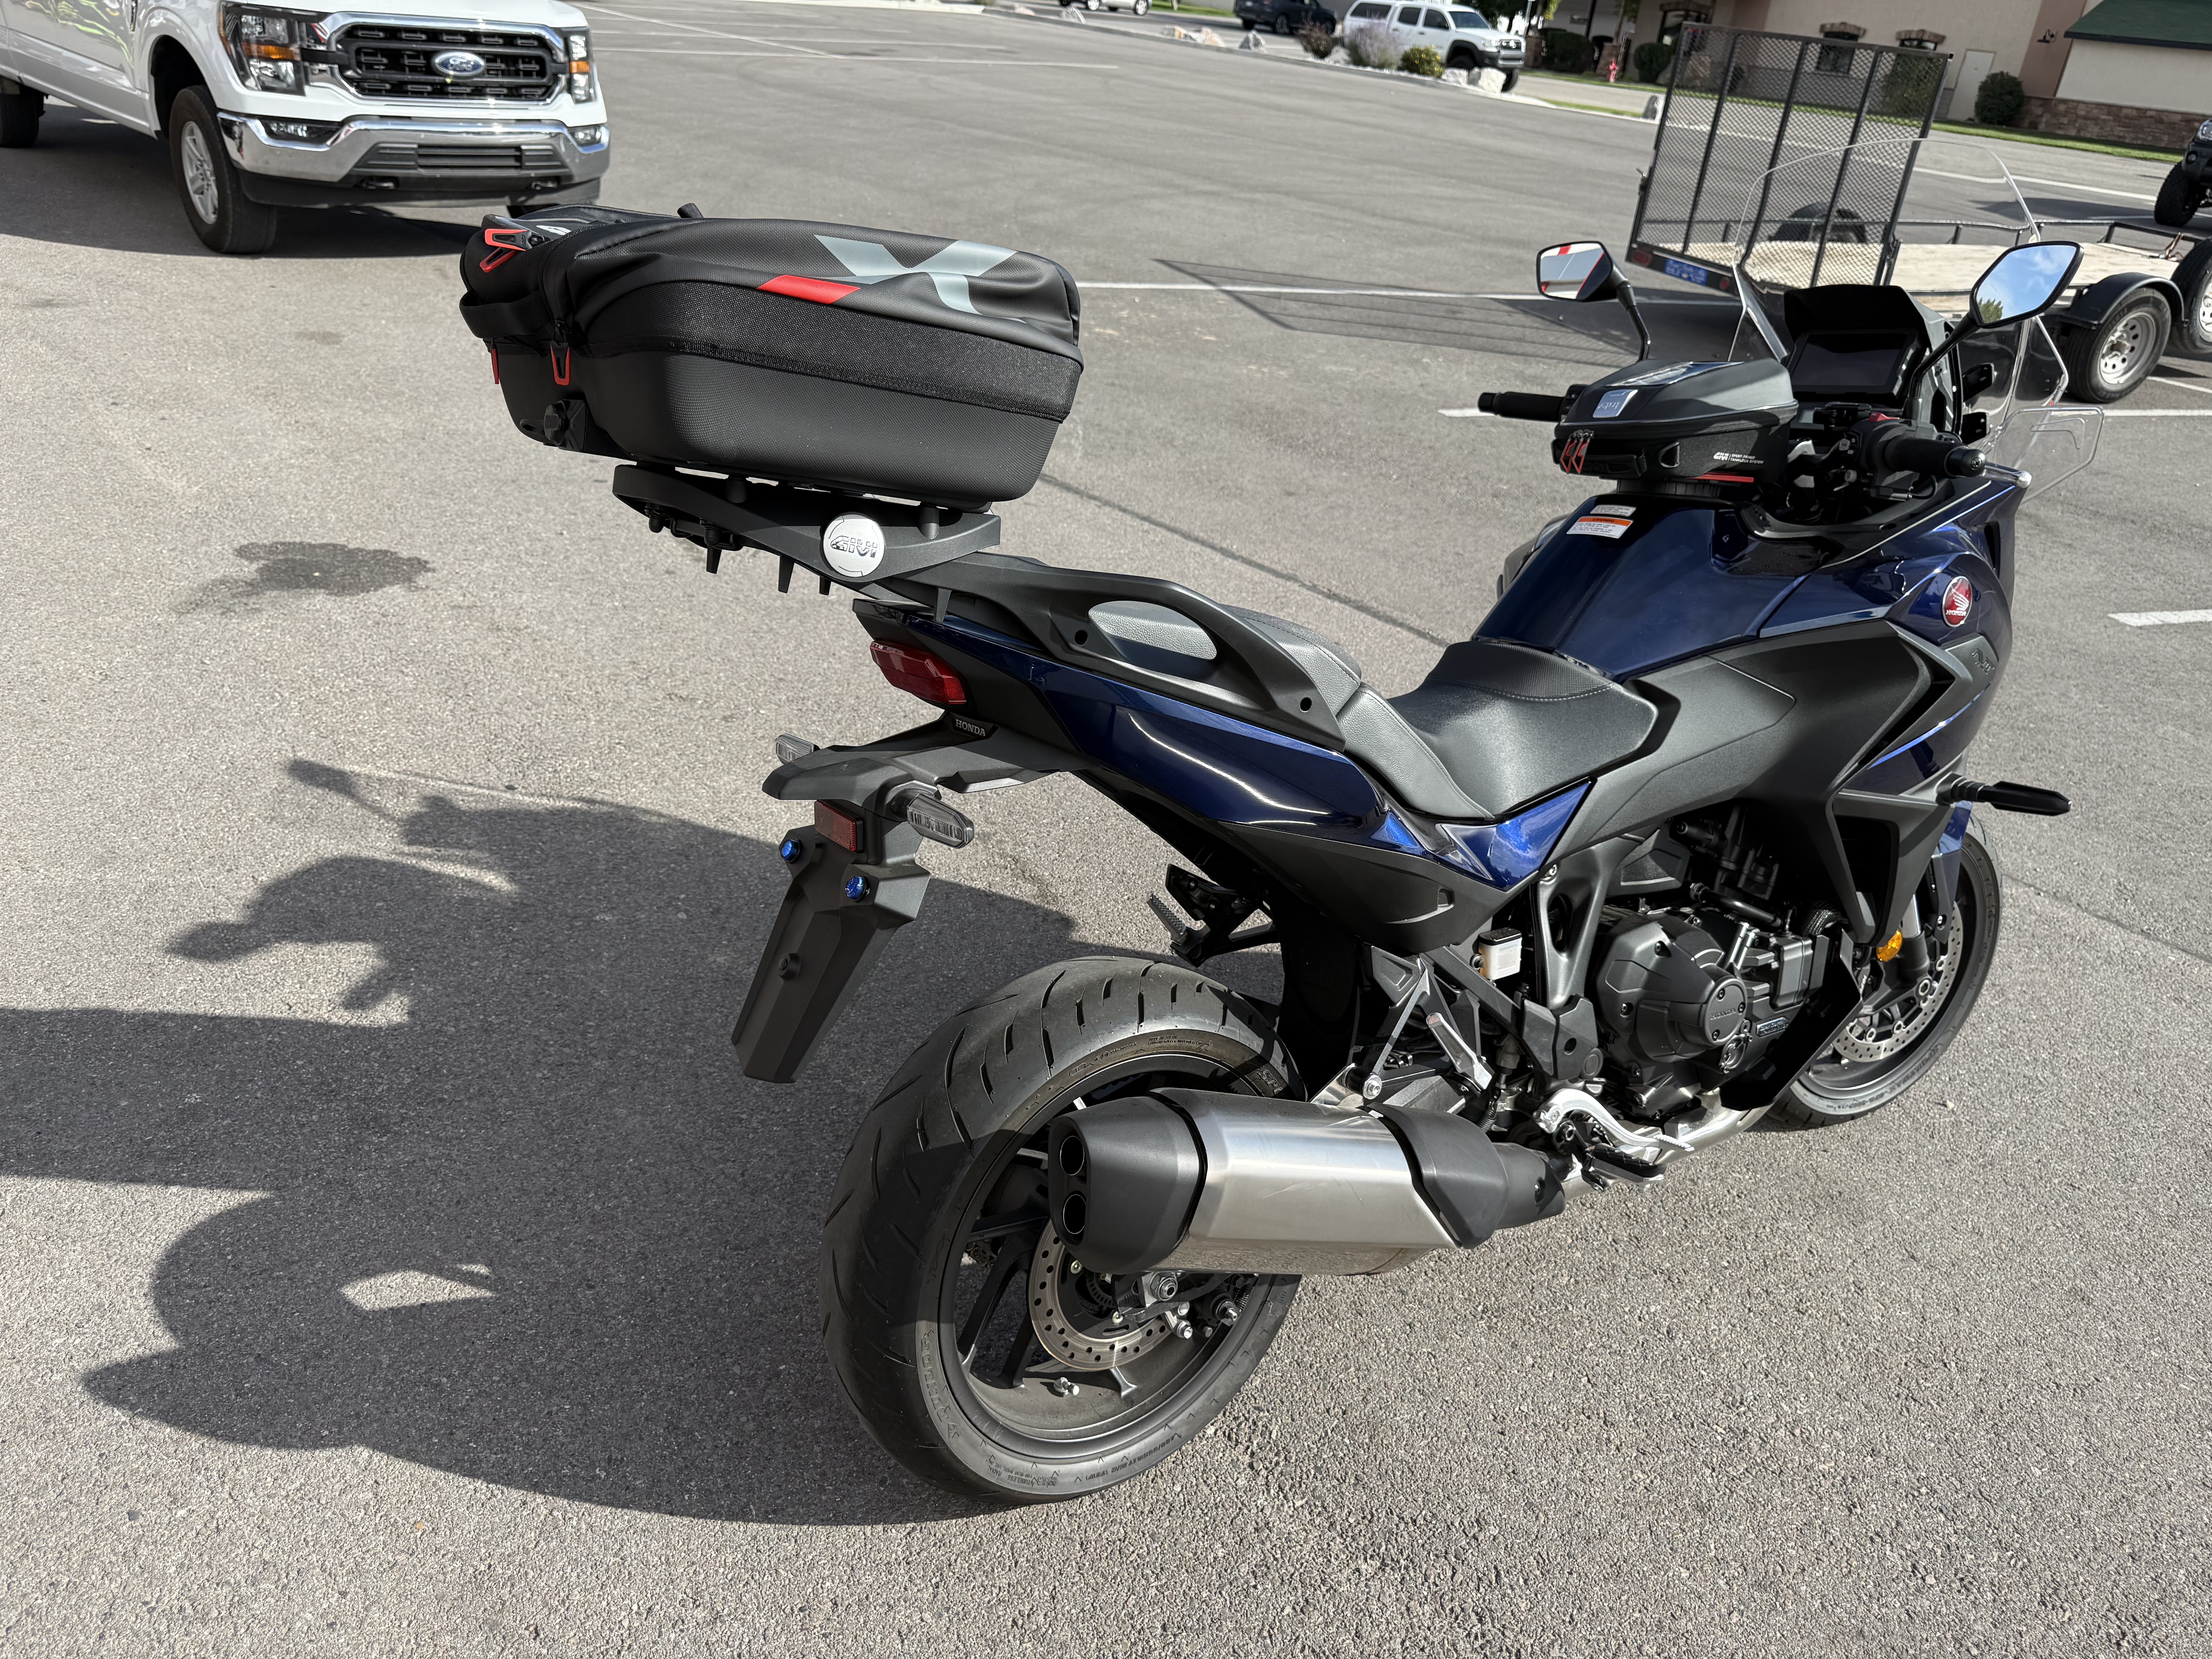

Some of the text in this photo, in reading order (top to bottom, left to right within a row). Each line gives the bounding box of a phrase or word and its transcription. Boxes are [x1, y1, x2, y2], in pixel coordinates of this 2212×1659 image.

[447, 58, 474, 71] Ford
[1713, 452, 1729, 461] GIVI
[831, 535, 878, 558] GIVI
[955, 719, 986, 737] HONDA
[1710, 1008, 1736, 1020] HONDA
[988, 1465, 1002, 1477] RADIAL
